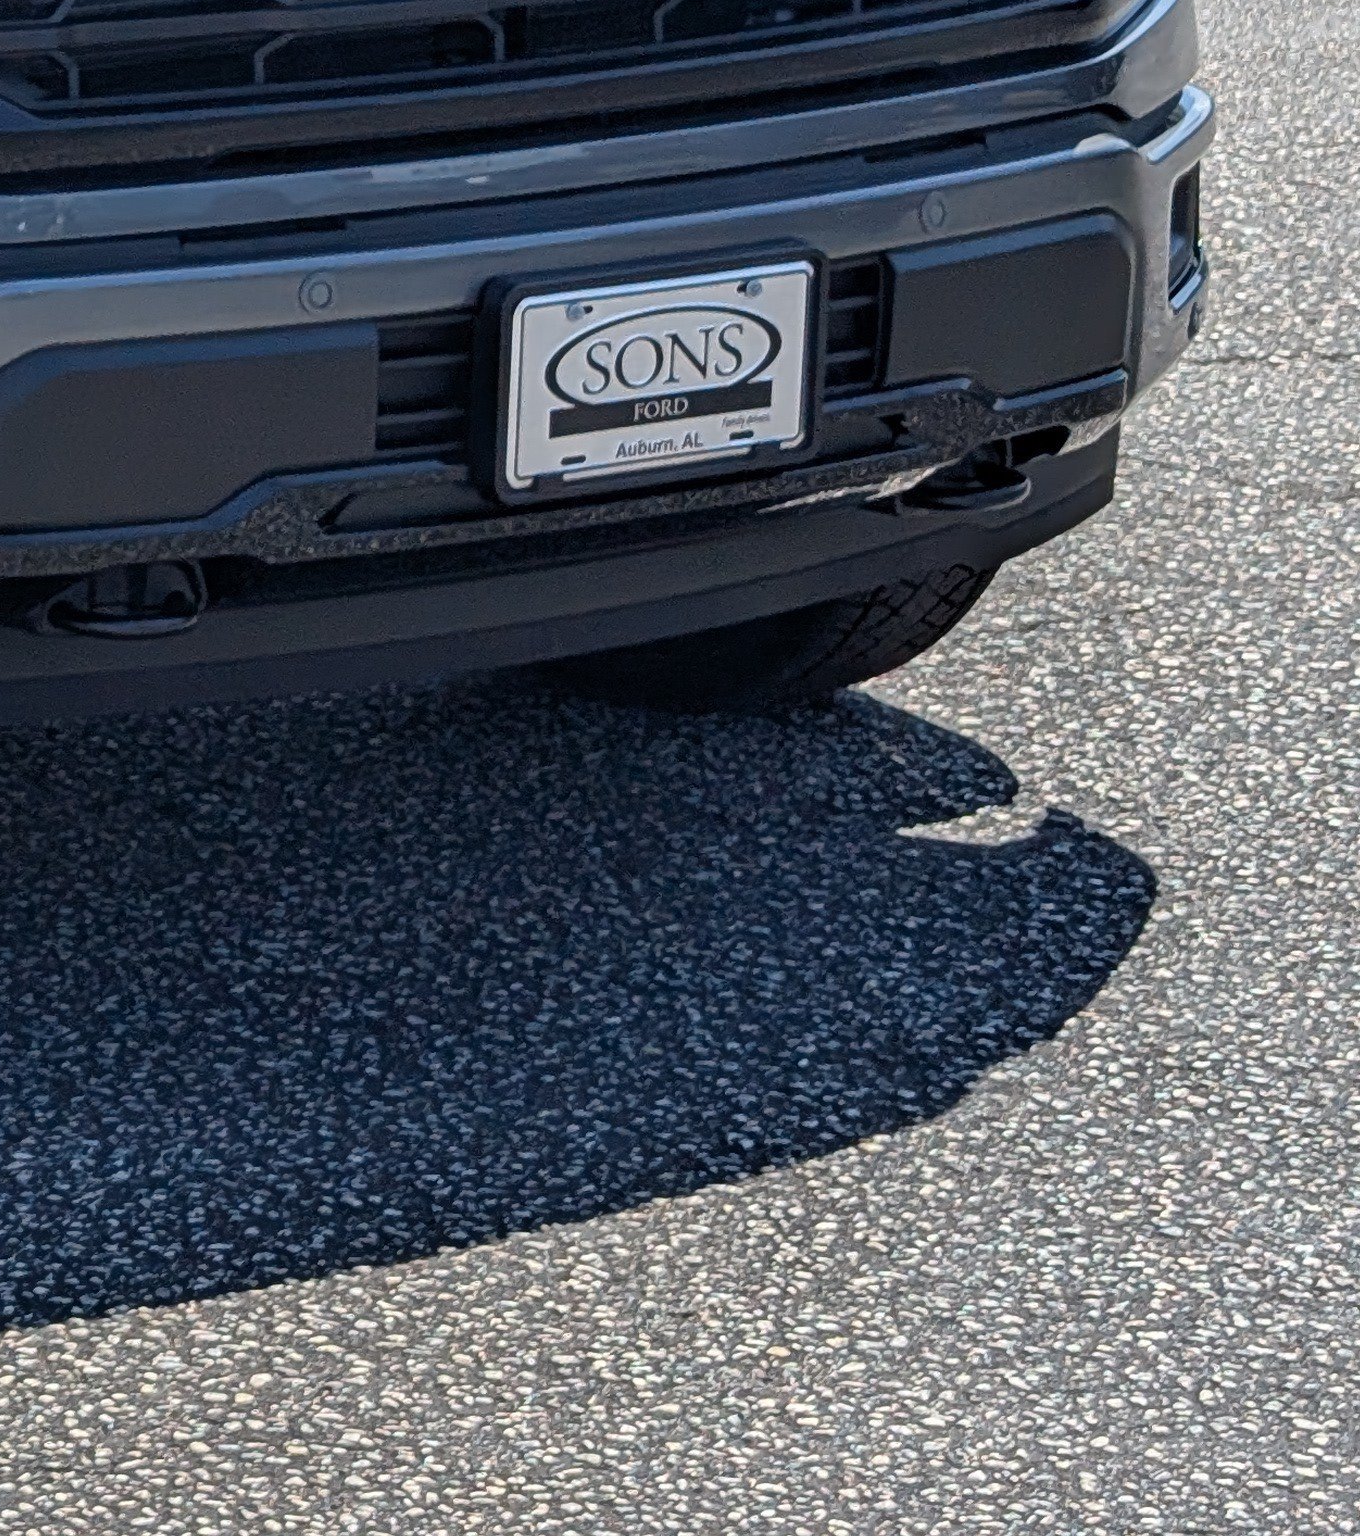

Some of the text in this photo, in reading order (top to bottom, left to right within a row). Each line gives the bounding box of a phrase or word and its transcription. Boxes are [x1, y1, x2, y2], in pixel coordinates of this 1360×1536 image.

[581, 322, 744, 395] SONS
[633, 397, 688, 422] FORD
[615, 431, 704, 459] Auburn, AL
